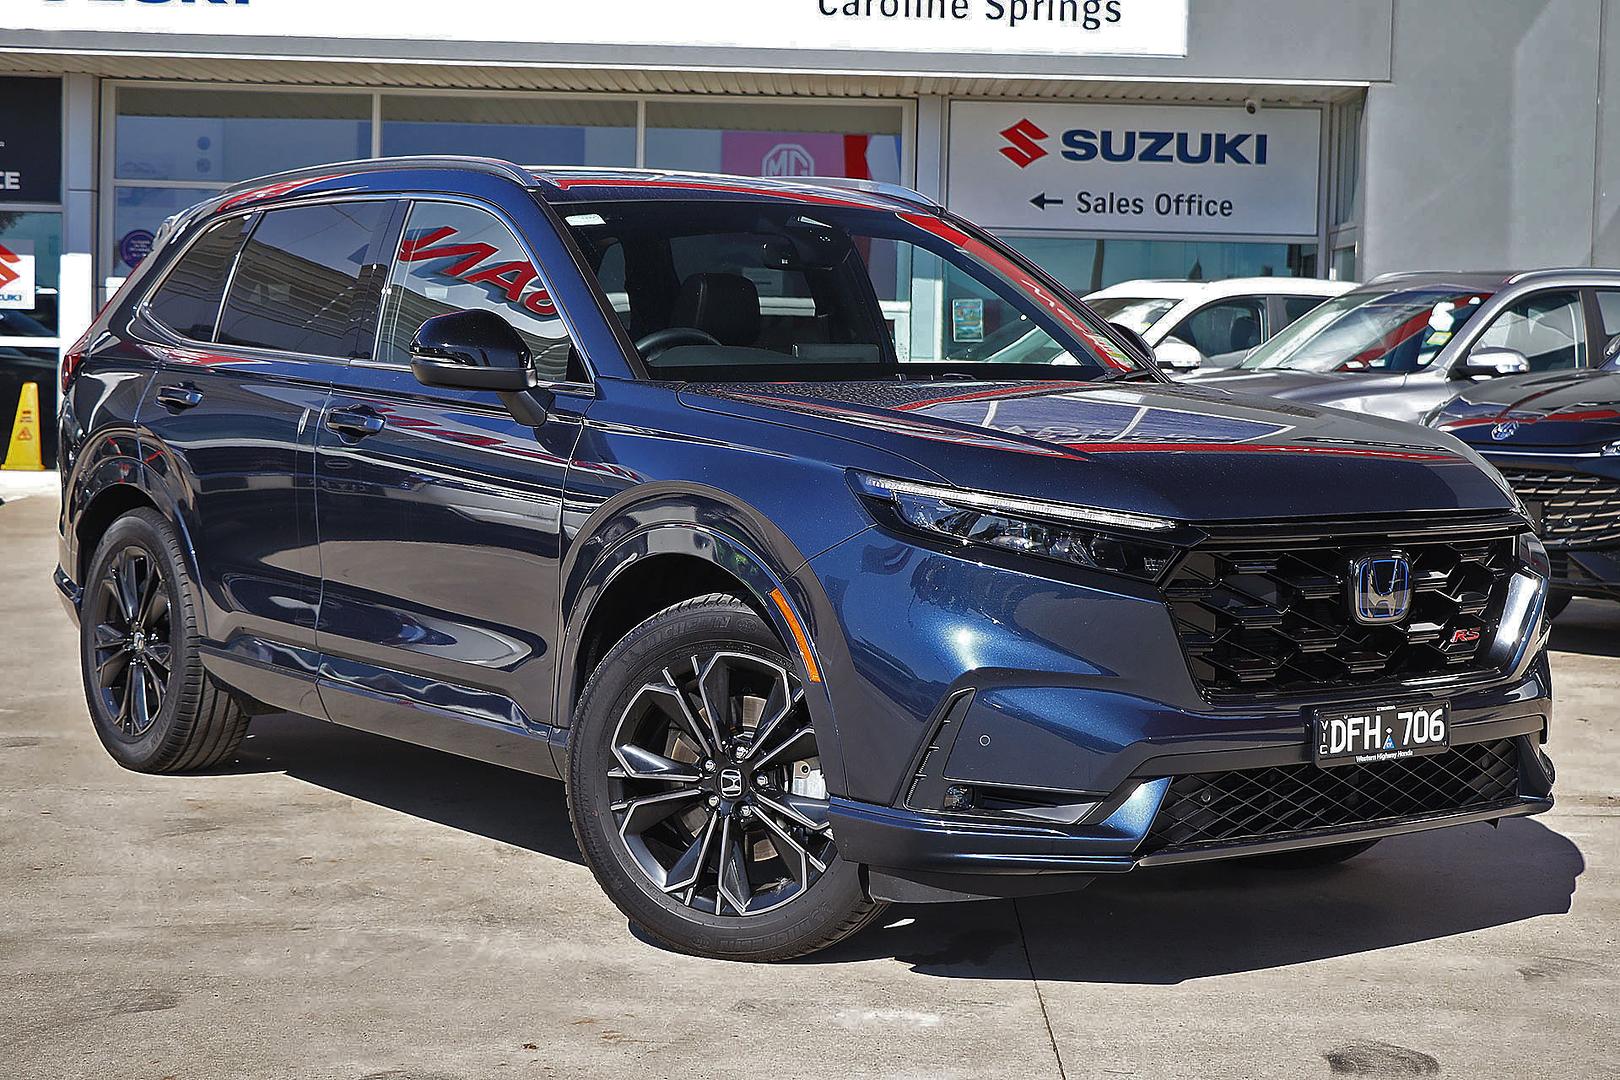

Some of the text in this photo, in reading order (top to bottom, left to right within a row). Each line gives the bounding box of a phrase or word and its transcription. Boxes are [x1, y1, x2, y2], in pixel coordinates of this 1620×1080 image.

[985, 0, 1121, 30] Springs
[1061, 129, 1267, 165] SUZUKI
[1077, 191, 1233, 217] Sales Office
[0, 293, 22, 302] UKI
[1450, 627, 1481, 643] RS
[1329, 708, 1445, 754] DFH 706
[1355, 748, 1413, 763] Western Highway Honda
